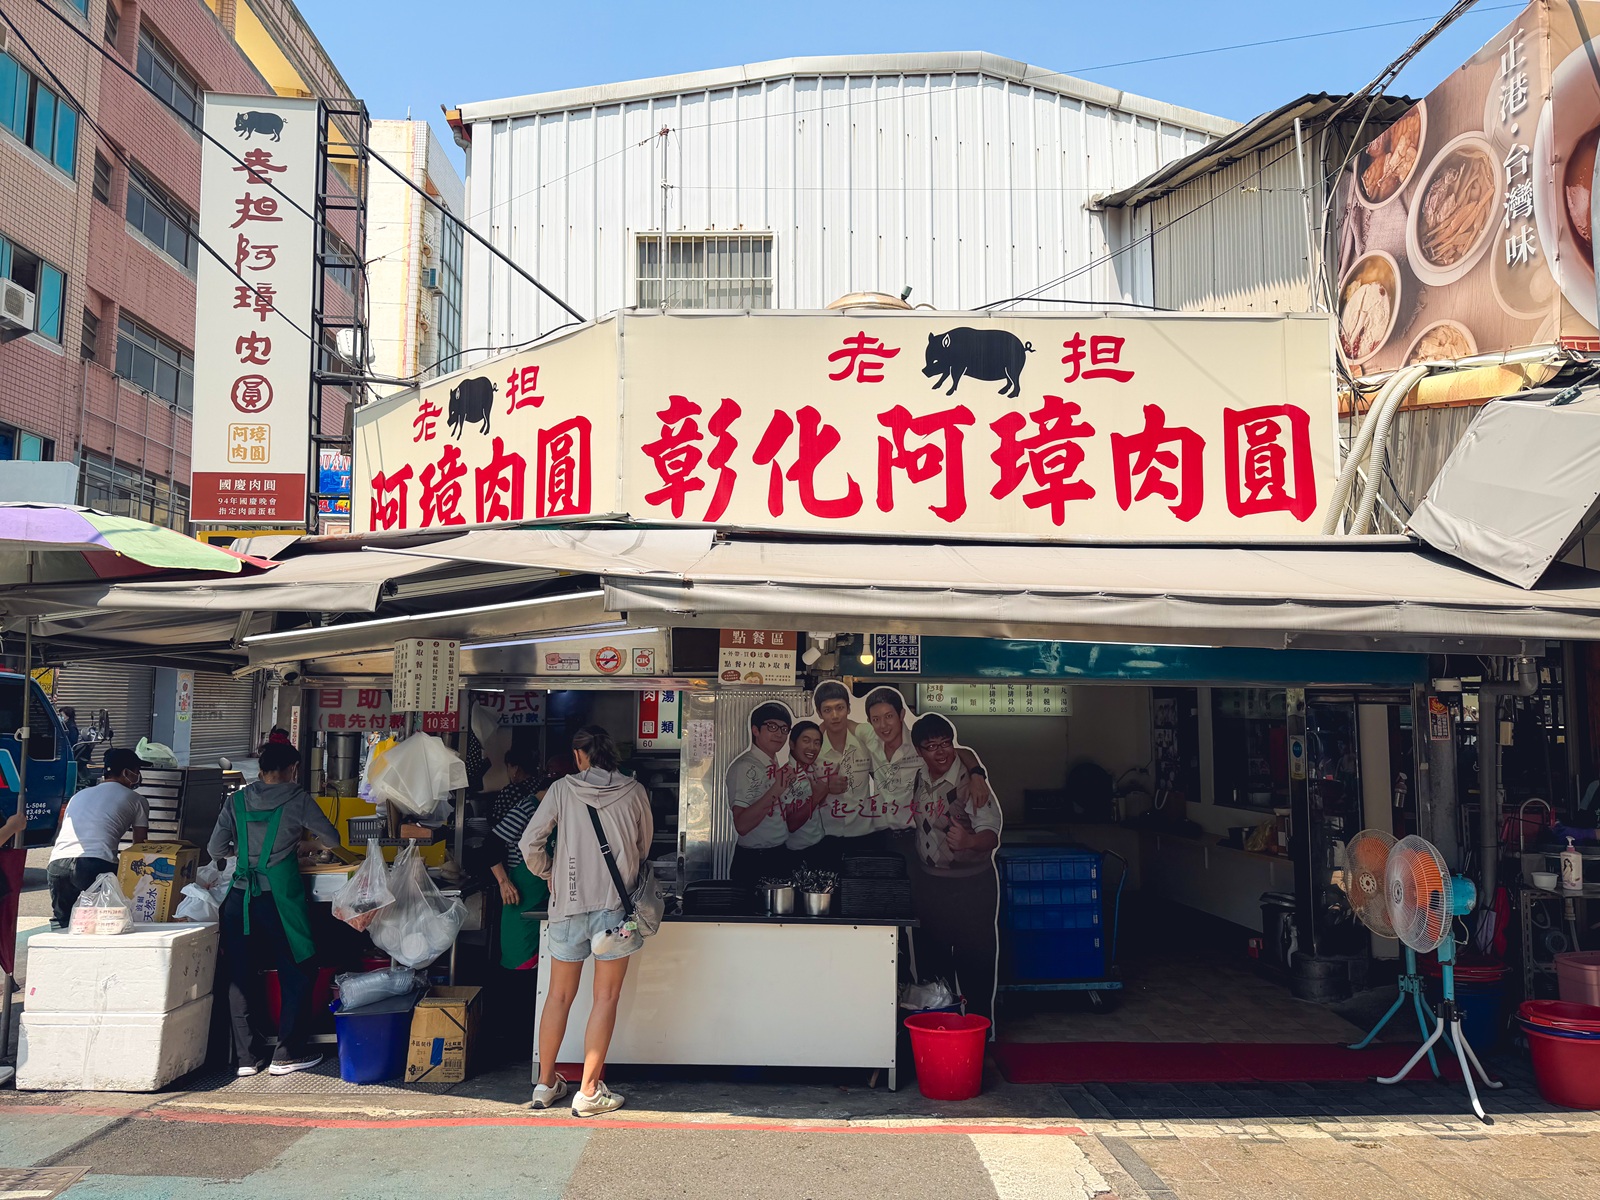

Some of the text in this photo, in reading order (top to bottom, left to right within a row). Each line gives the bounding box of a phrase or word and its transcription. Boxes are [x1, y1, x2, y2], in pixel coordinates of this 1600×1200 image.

[641, 394, 1318, 526] 彰化阿璋肉圓
[371, 415, 592, 532] 阿璋肉圓
[219, 479, 276, 491] 國慶肉圓
[732, 631, 784, 645] 點餐區
[889, 635, 918, 644] 長樂里
[877, 635, 887, 670] 彰化市
[889, 646, 918, 655] 長安街
[889, 658, 918, 670] 144號
[427, 717, 456, 729] 10送1
[642, 740, 653, 748] 60
[766, 761, 839, 787] 那些年
